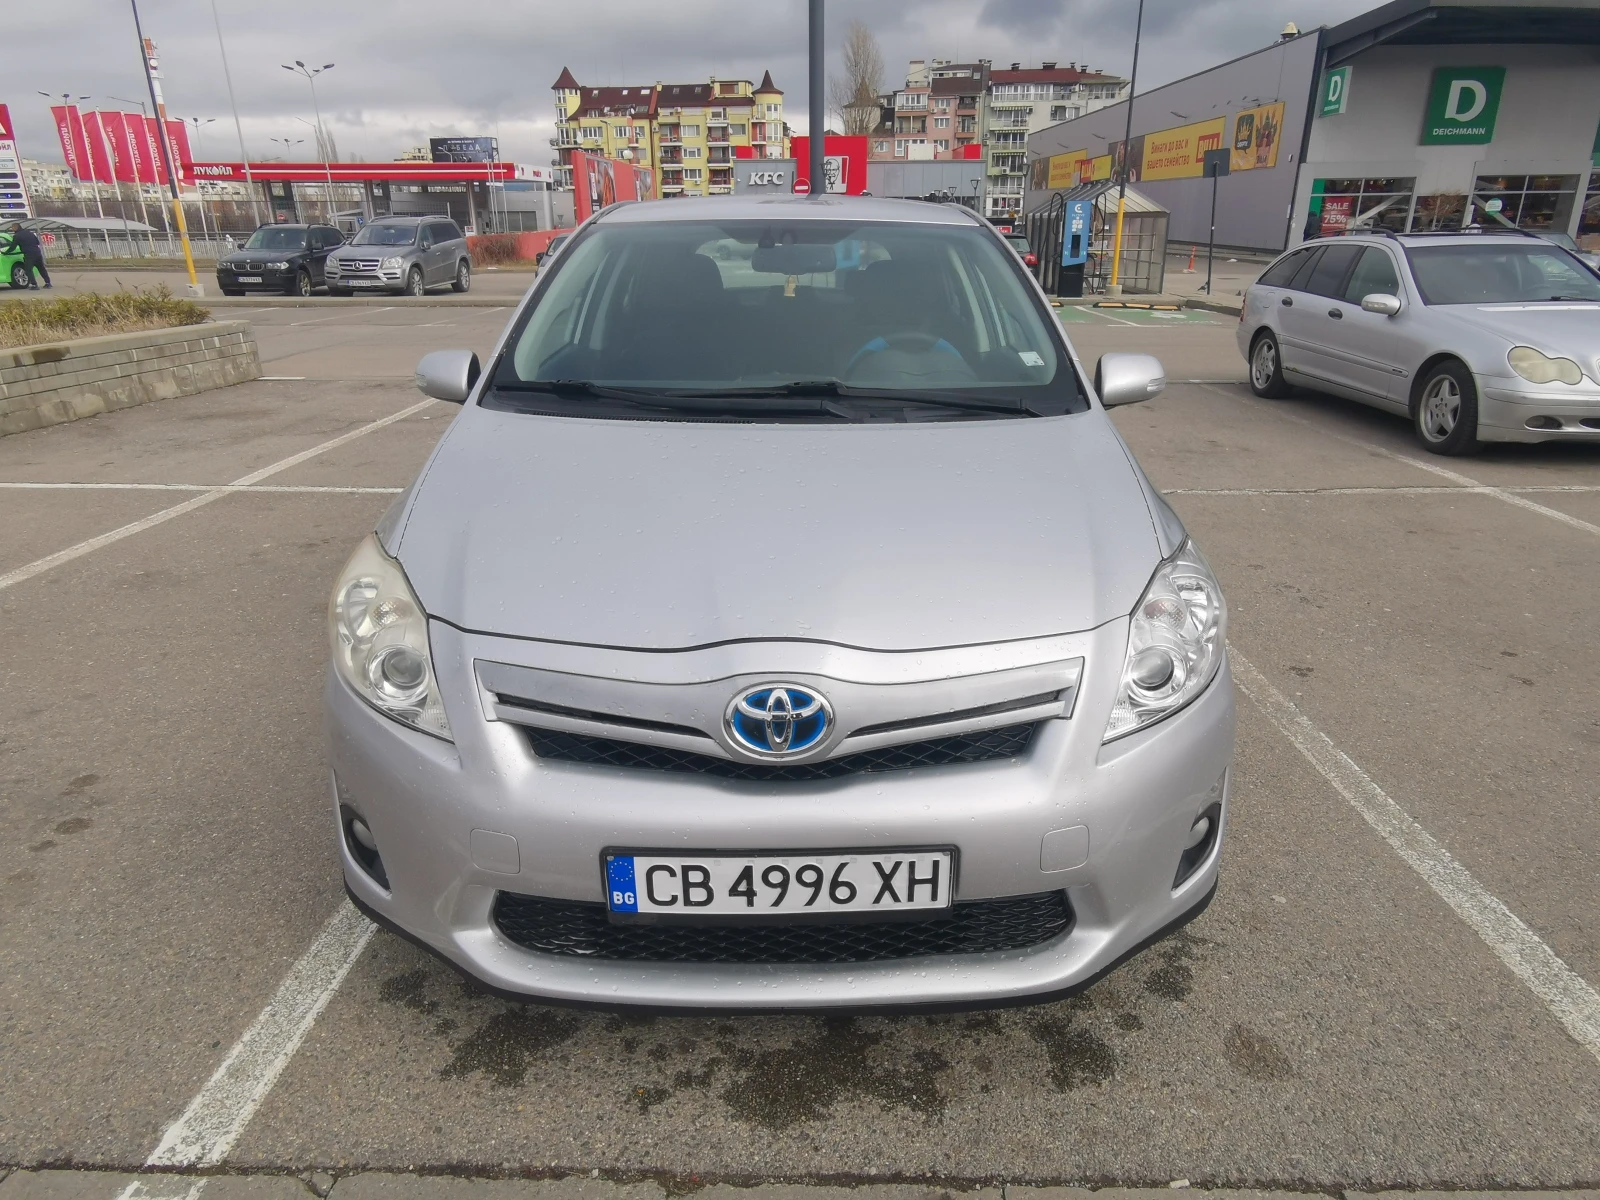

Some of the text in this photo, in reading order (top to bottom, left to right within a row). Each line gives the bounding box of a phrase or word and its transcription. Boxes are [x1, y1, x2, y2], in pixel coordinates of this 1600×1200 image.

[1328, 75, 1341, 101] D
[1444, 79, 1487, 122] D
[1433, 127, 1486, 135] DEICHMANN
[749, 172, 784, 185] KFC
[1326, 202, 1349, 210] SALE
[1324, 215, 1347, 223] 75%
[728, 861, 857, 908] 4996
[613, 891, 635, 905] BG
